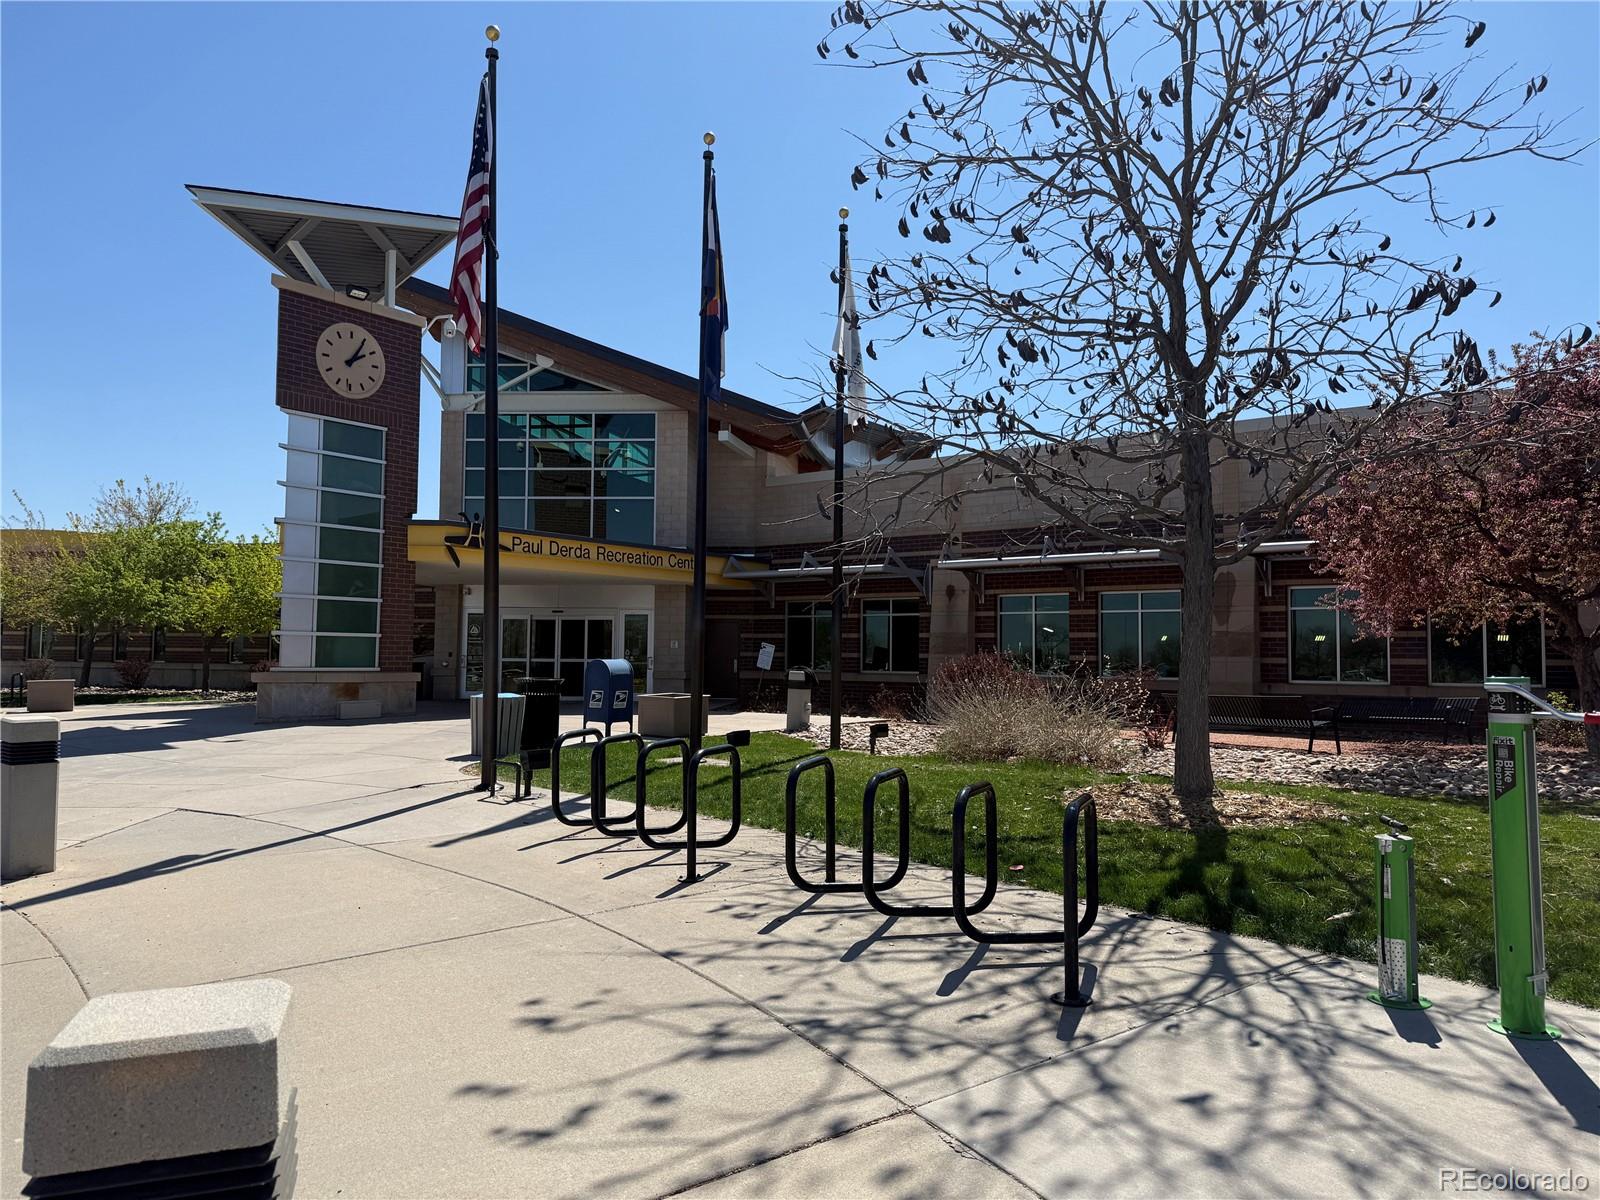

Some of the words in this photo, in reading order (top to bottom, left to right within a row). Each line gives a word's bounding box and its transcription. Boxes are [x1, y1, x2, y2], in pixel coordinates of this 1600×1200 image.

[512, 536, 543, 555] Paul
[550, 541, 591, 560] Derda
[597, 546, 663, 566] Recreation
[668, 554, 695, 570] Cent
[1495, 760, 1504, 793] Repair
[1504, 760, 1514, 783] Bike
